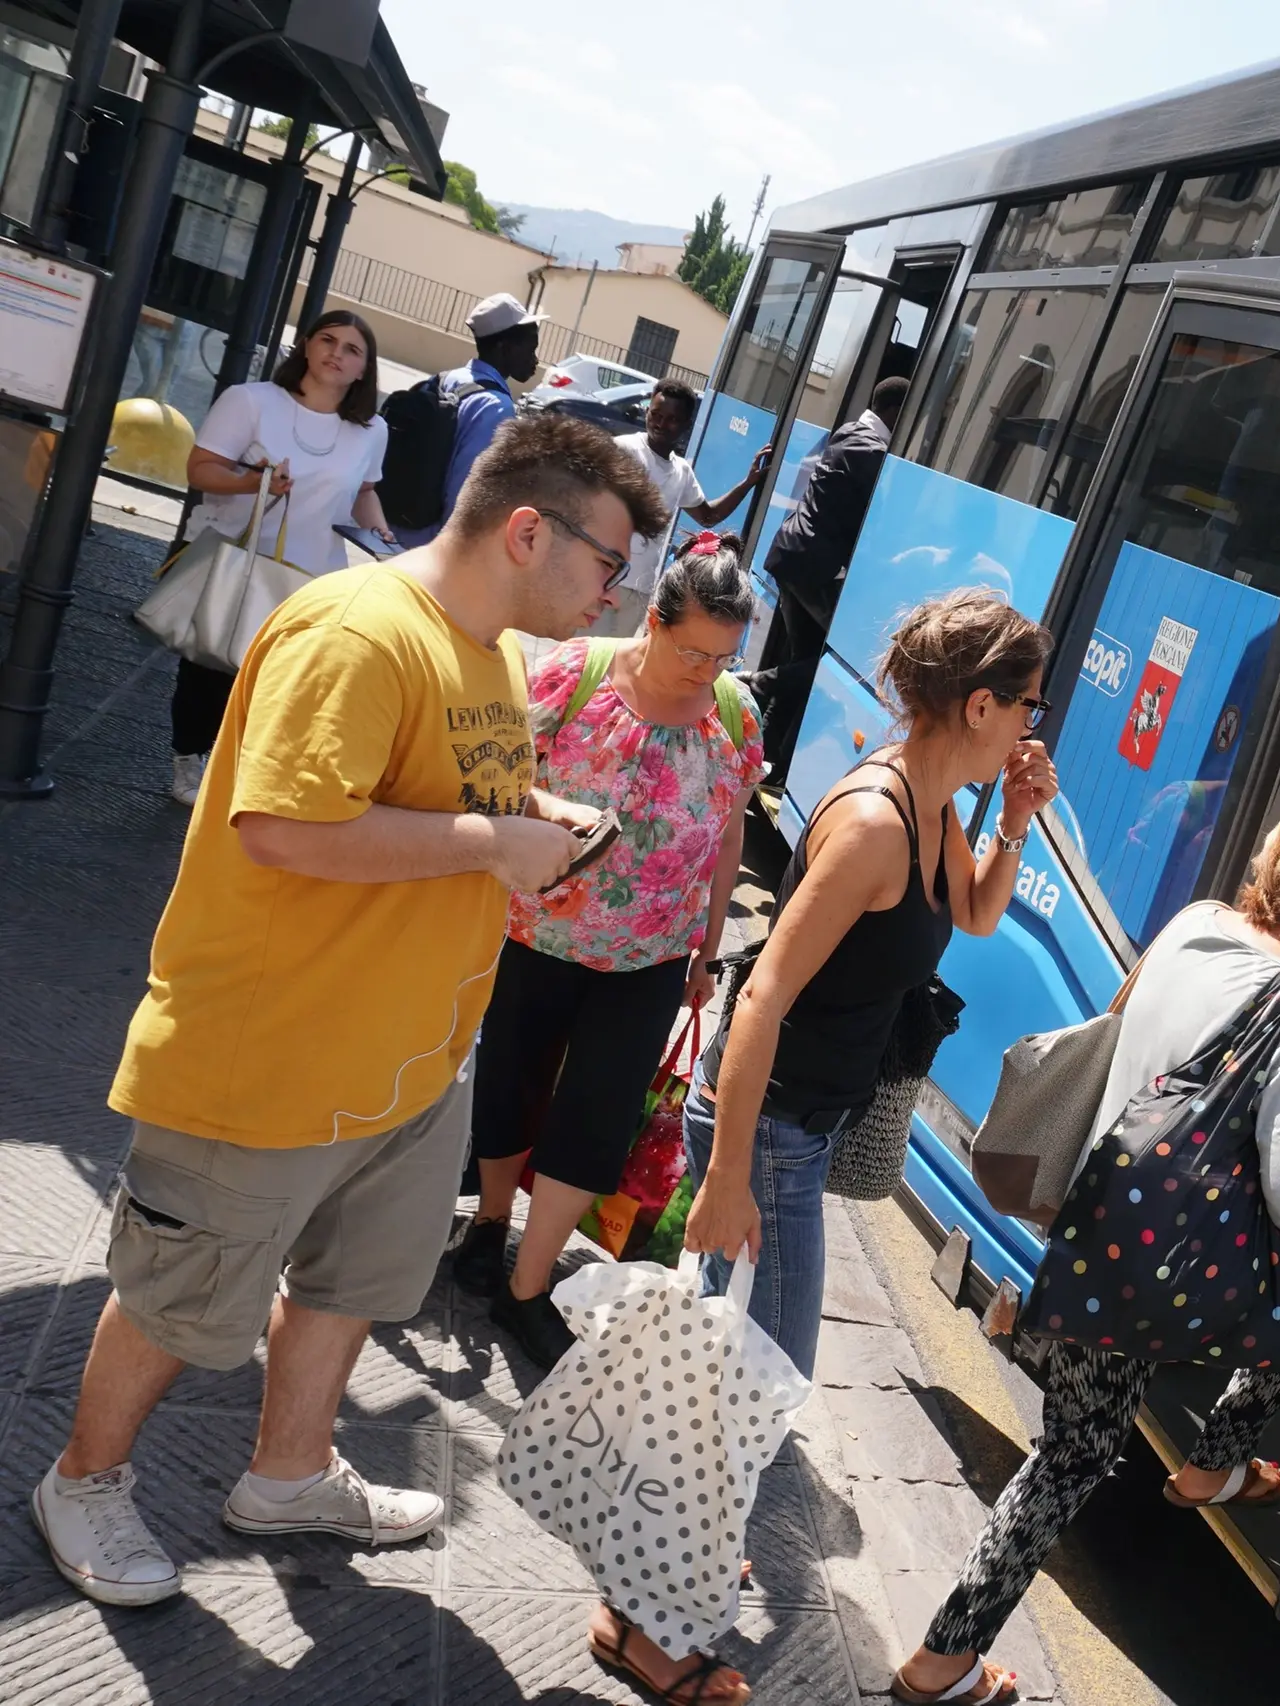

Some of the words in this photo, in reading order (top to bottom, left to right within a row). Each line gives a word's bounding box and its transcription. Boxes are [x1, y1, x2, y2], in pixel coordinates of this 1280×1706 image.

[729, 415, 750, 437] uscita
[1160, 619, 1197, 650] REGIONE
[1083, 639, 1127, 690] copit
[1152, 639, 1188, 671] TOSCANA
[447, 707, 484, 732] LEVI
[942, 1107, 974, 1141] POWERE
